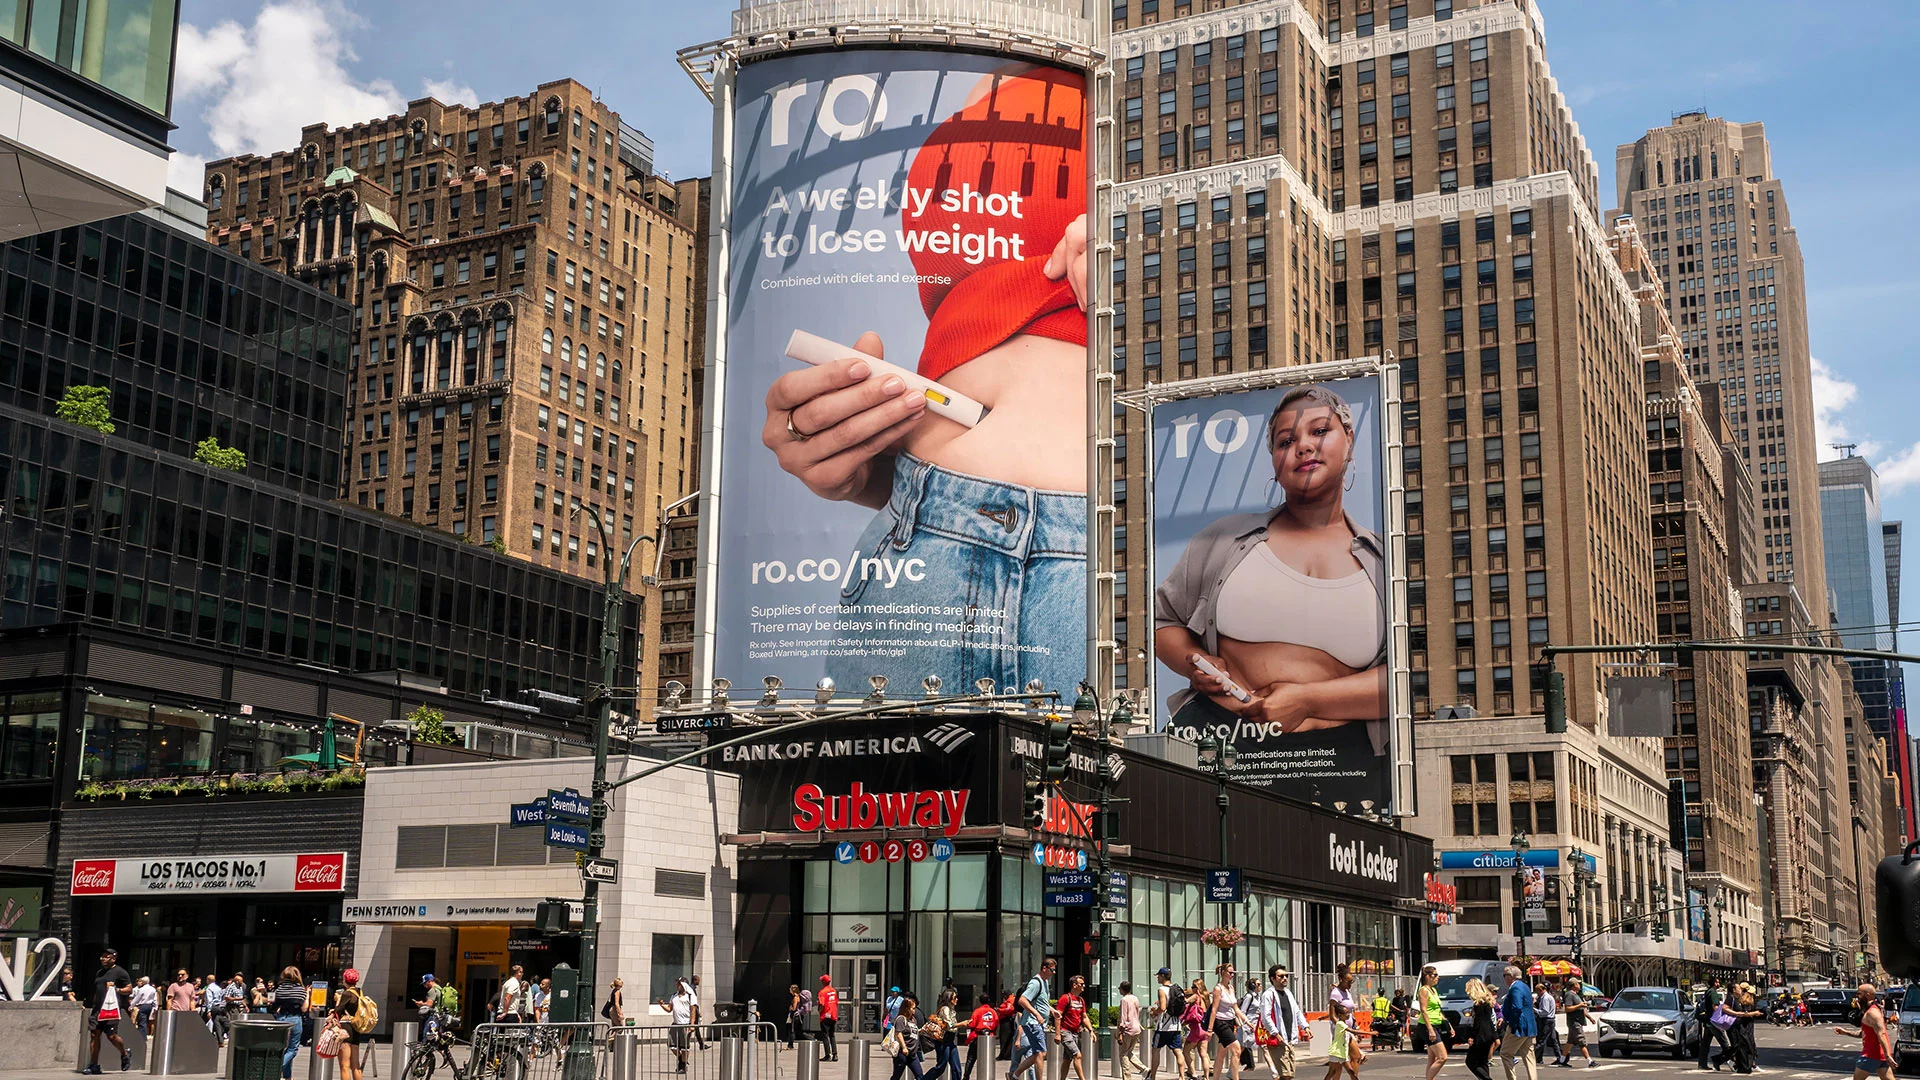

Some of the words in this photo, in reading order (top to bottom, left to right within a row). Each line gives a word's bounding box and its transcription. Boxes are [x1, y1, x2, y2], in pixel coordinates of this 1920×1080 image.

[764, 75, 888, 147] ro
[762, 186, 791, 217] A
[798, 179, 933, 218] weekly
[940, 183, 1024, 219] shot
[762, 232, 800, 258] to
[809, 224, 887, 254] lose
[895, 223, 1025, 265] weight
[760, 274, 821, 290] Combined
[823, 272, 848, 284] with
[850, 272, 874, 283] diet
[876, 272, 899, 283] and
[901, 273, 952, 285] exercise
[1170, 409, 1249, 459] ro
[751, 550, 926, 589] ro.co/nyc
[751, 603, 802, 619] Supplies
[803, 603, 817, 615] of
[818, 602, 861, 614] certain
[863, 602, 941, 615] medications
[943, 606, 963, 616] are
[965, 605, 1009, 619] limited.
[751, 622, 784, 634] There
[786, 622, 812, 635] may
[815, 620, 831, 631] be
[833, 619, 873, 634] delays
[875, 619, 886, 631] in
[889, 619, 932, 634] finding
[935, 621, 1006, 635] medication.
[749, 651, 774, 660] Boxed
[775, 650, 810, 659] Warning,
[819, 648, 906, 658] ro.co/safety-info/glp1
[761, 641, 778, 650] only.
[779, 639, 794, 648] See
[795, 638, 836, 649] Important
[837, 638, 864, 648] Safety
[865, 638, 913, 647] Information
[914, 639, 938, 647] about
[939, 639, 964, 648] GLP-1
[965, 641, 1016, 652] medications,
[1016, 644, 1050, 656] including
[723, 742, 783, 763] BANK
[785, 741, 816, 760] OF
[818, 736, 922, 758] AMERICA
[1244, 750, 1293, 759] medications
[1307, 747, 1337, 757] limited.
[1230, 762, 1251, 771] elays
[1259, 760, 1288, 770] finding
[1288, 759, 1336, 769] medication.
[1342, 770, 1367, 778] including
[551, 796, 577, 814] Seventh
[577, 802, 589, 816] Ave
[793, 781, 971, 838] Subway
[516, 809, 543, 822] West
[550, 828, 561, 841] Joe
[561, 829, 576, 844] Louis
[932, 843, 952, 858] MTA
[1329, 832, 1358, 875] Foot
[1360, 840, 1399, 883] Locker
[141, 862, 173, 879] LOS
[175, 860, 230, 878] TACOS
[232, 859, 267, 878] No.1
[175, 881, 193, 889] POLLO
[1050, 875, 1068, 884] West
[1083, 875, 1091, 884] St
[1055, 894, 1084, 904] Plaza33
[345, 905, 373, 917] PENN
[375, 904, 416, 917] STATION
[455, 907, 469, 916] Long
[469, 906, 485, 914] Island
[485, 906, 495, 914] Rail
[495, 906, 510, 914] Road
[515, 906, 536, 916] Subway
